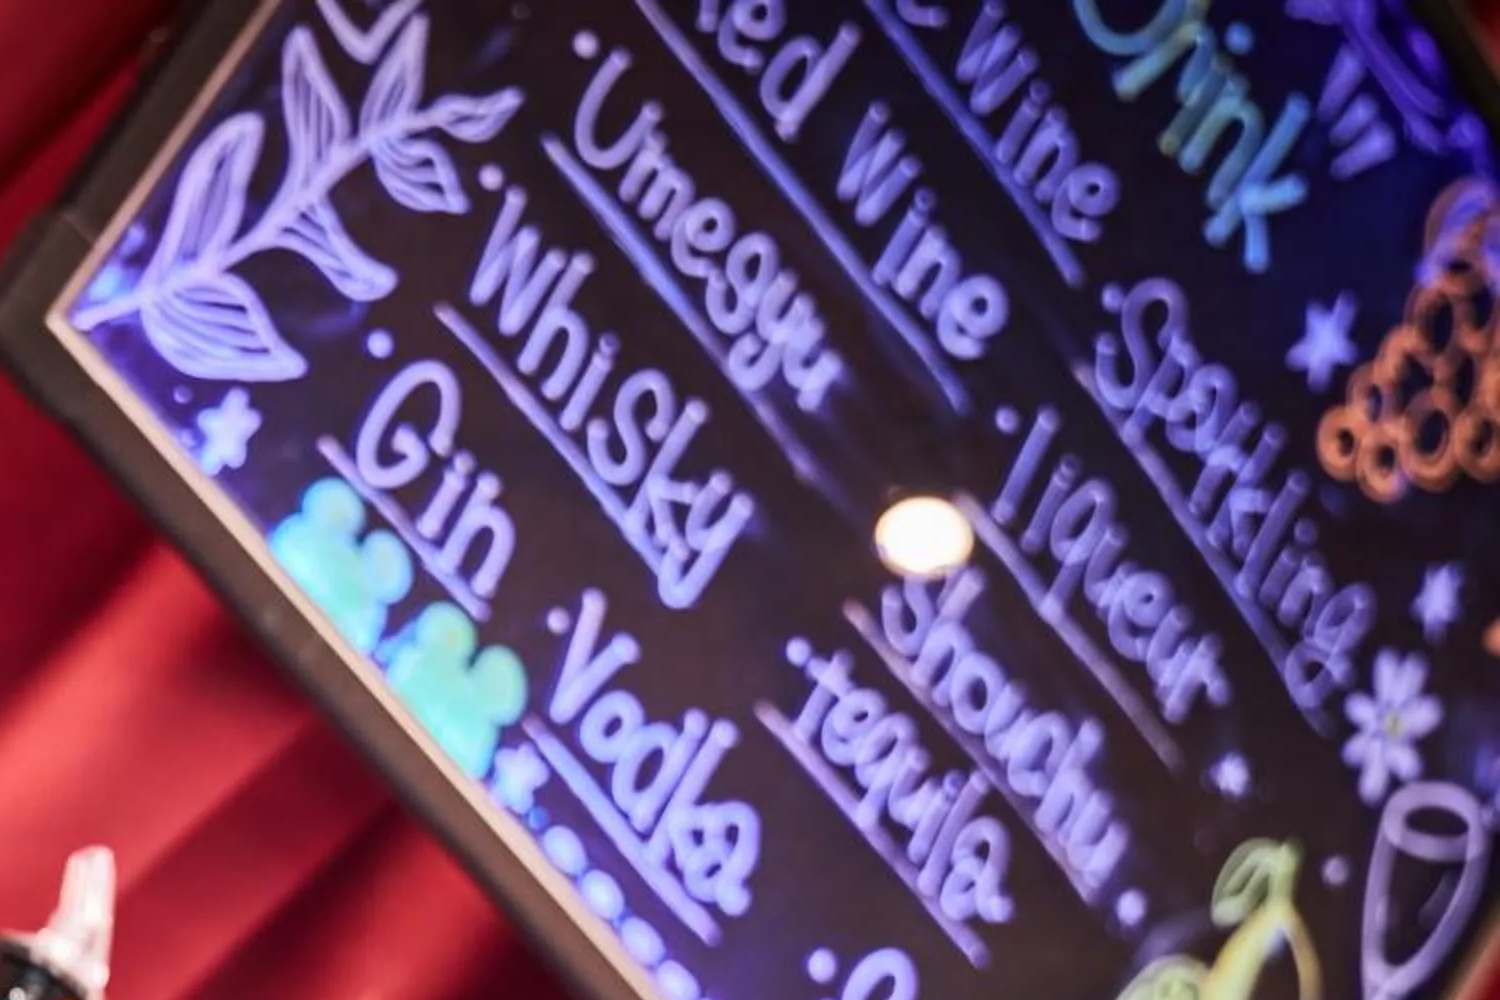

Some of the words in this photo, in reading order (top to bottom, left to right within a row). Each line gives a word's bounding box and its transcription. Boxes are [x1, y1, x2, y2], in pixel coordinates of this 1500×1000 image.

[696, 0, 861, 142] ed
[836, 100, 1009, 360] Wine
[956, 0, 1120, 241] Wine
[356, 359, 516, 597] Gin
[550, 587, 762, 918] Vodka
